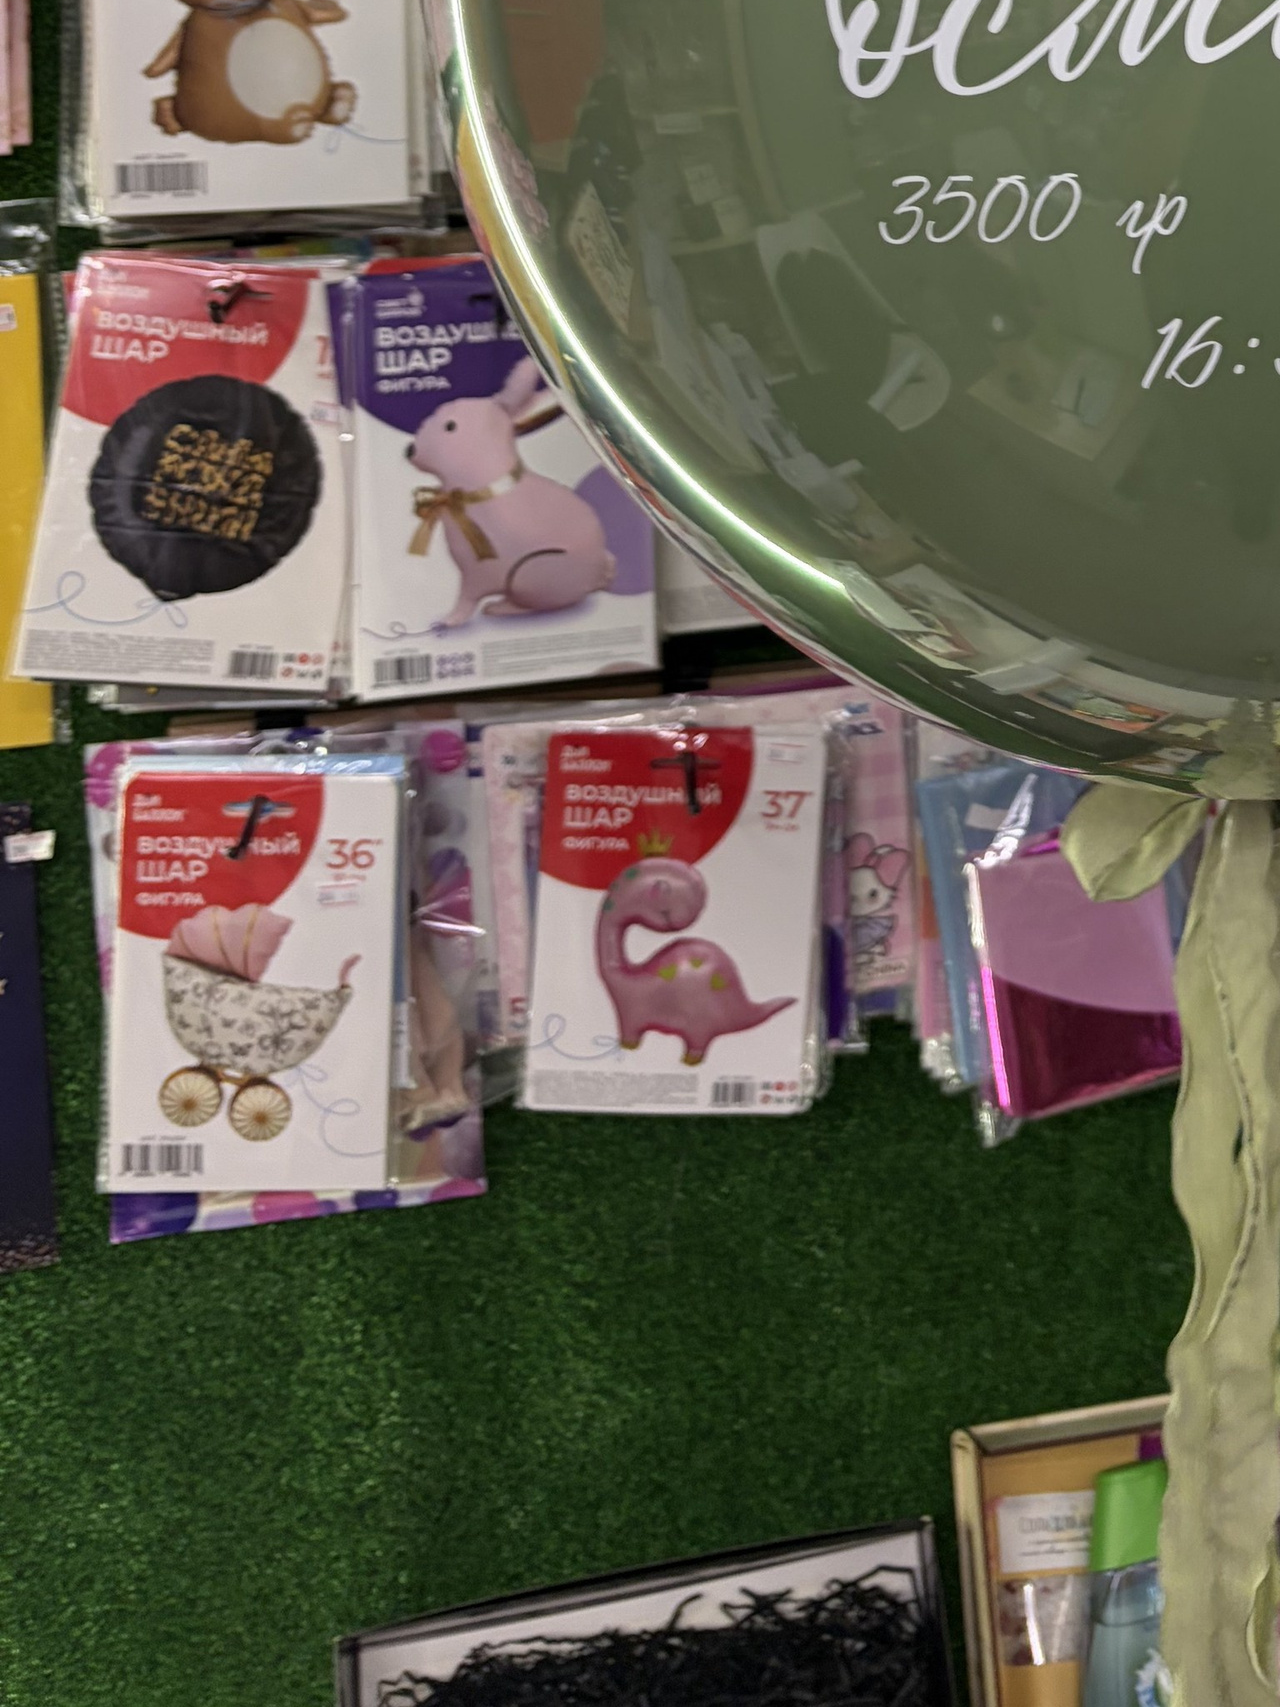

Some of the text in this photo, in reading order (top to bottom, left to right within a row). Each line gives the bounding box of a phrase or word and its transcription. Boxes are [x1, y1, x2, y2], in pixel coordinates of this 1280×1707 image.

[878, 173, 1082, 245] 3500
[95, 309, 269, 345] ВОЗДУШНЫЙ
[90, 335, 169, 363] ШАР
[374, 347, 452, 375] ШАР
[563, 807, 634, 829] ШАР
[136, 860, 209, 883] ШАР
[135, 892, 205, 906] ФИГУРА
